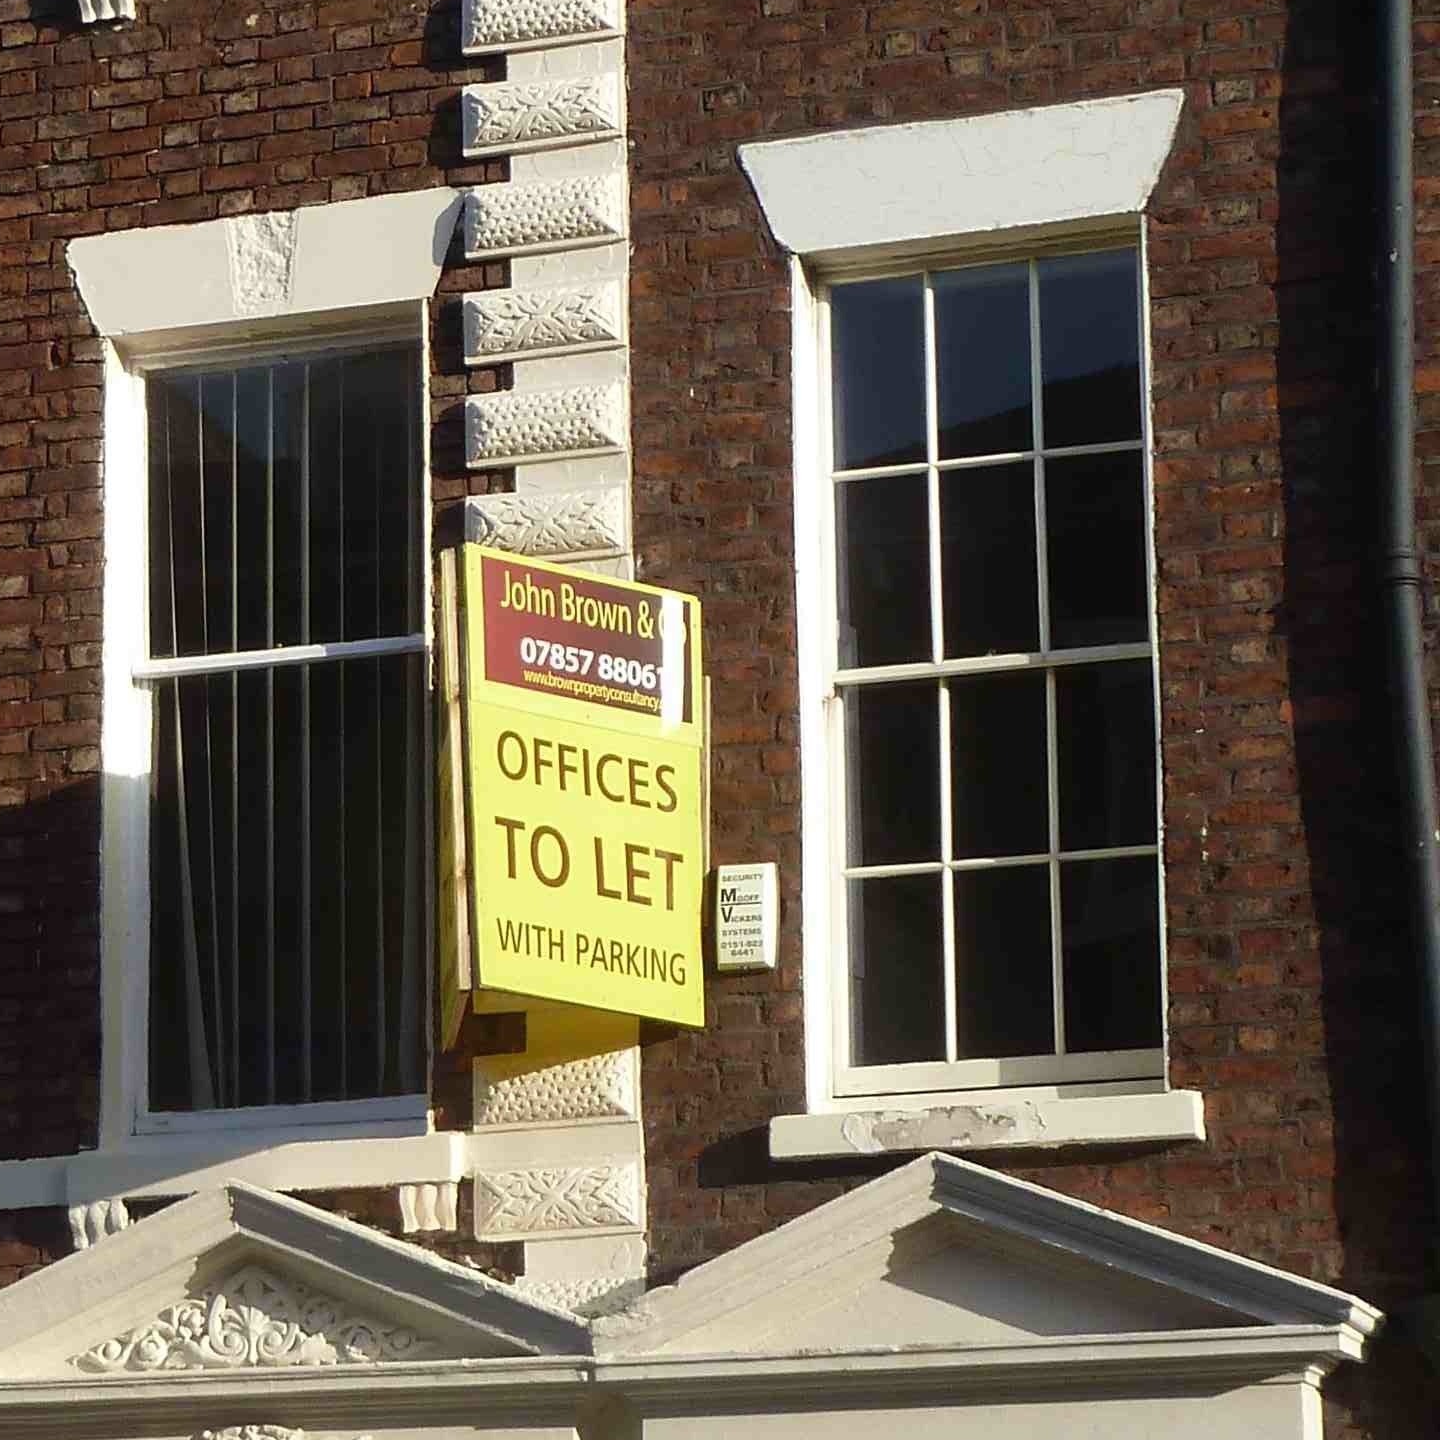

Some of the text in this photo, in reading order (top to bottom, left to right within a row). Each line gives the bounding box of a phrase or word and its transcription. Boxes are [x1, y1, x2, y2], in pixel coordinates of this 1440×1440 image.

[500, 570, 555, 618] John
[561, 583, 632, 635] Brown
[637, 600, 655, 639] &
[519, 636, 594, 676] 07857
[497, 730, 678, 813] OFFICES
[494, 815, 684, 911] TO LET
[496, 917, 686, 986] WITH PARKING
